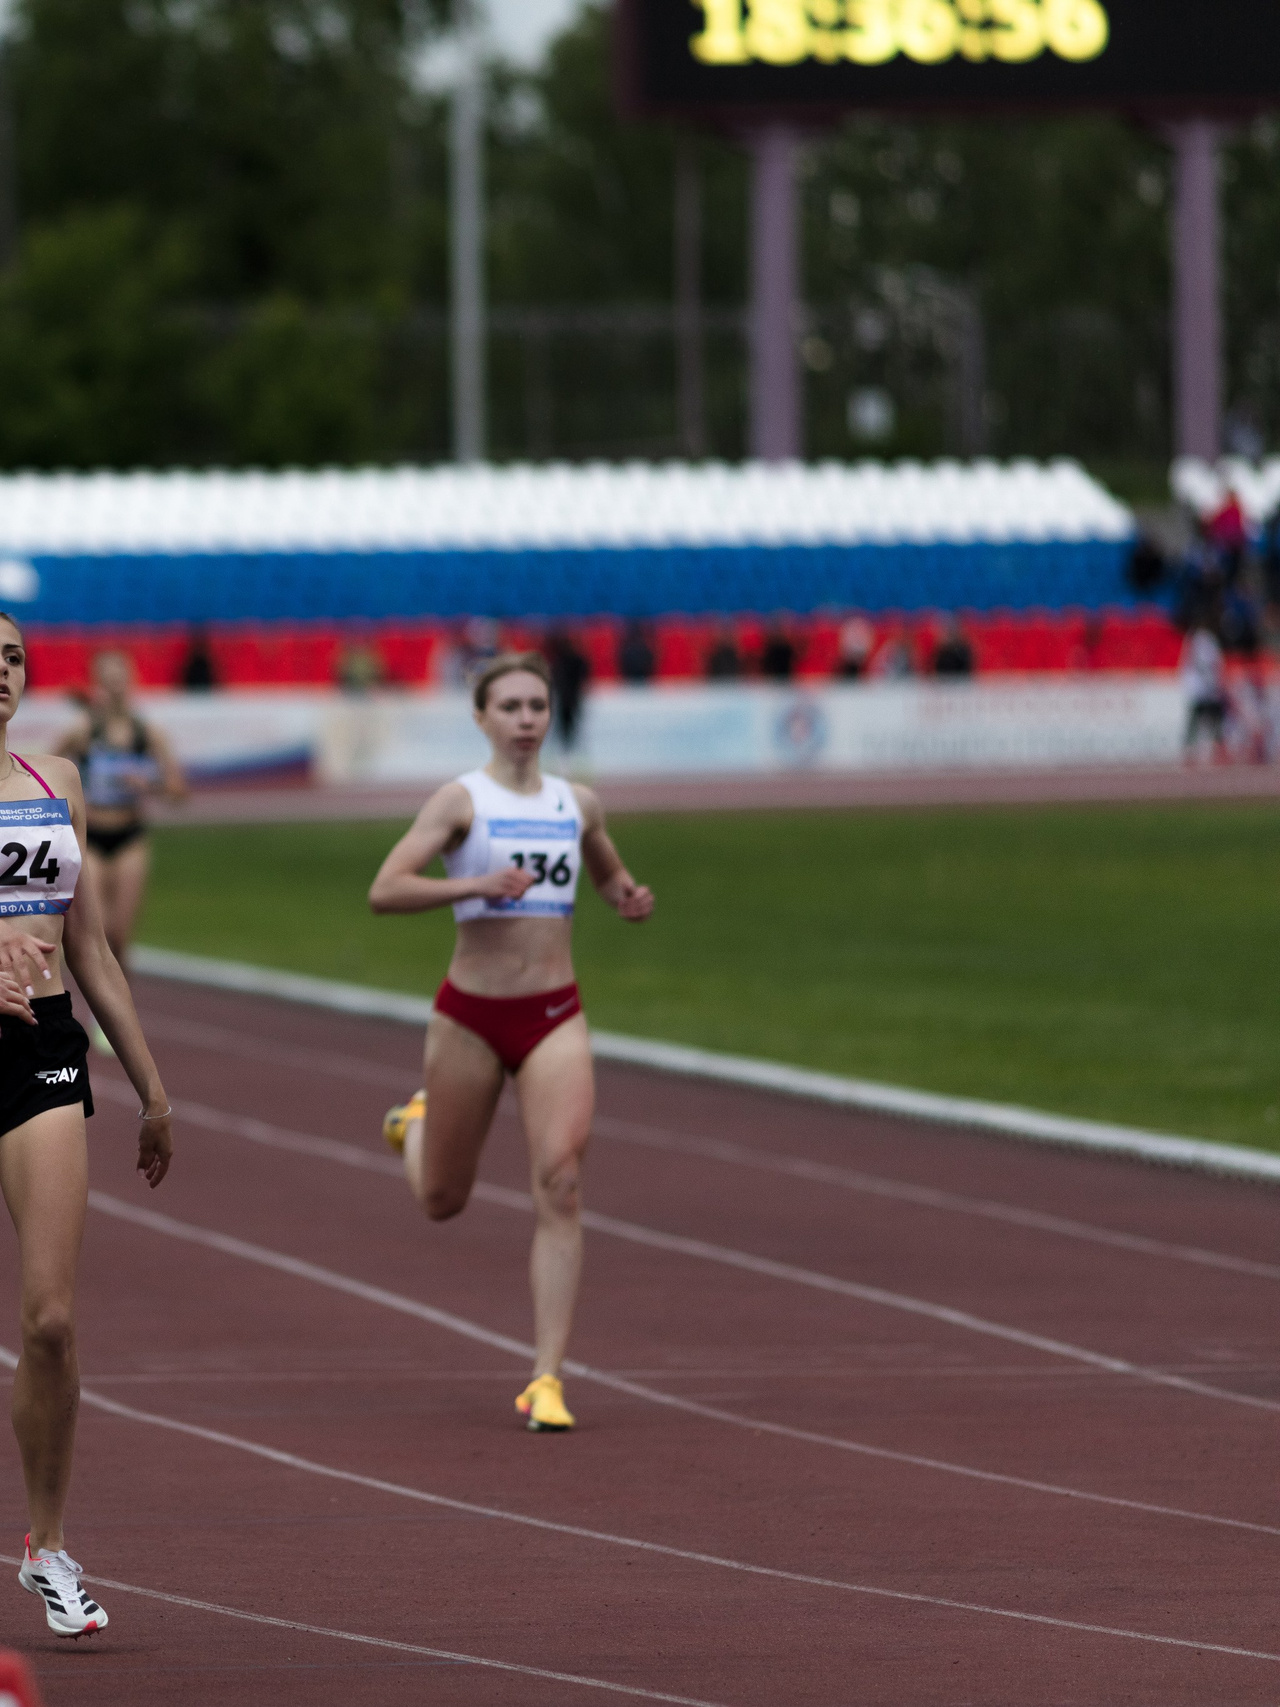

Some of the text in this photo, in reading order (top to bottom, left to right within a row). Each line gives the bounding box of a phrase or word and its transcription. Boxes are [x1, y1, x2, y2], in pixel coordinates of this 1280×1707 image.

[32, 812, 63, 820] ОКРУГА
[511, 852, 572, 887] 136
[0, 904, 34, 914] ВФЛА
[34, 1067, 79, 1085] RAY
